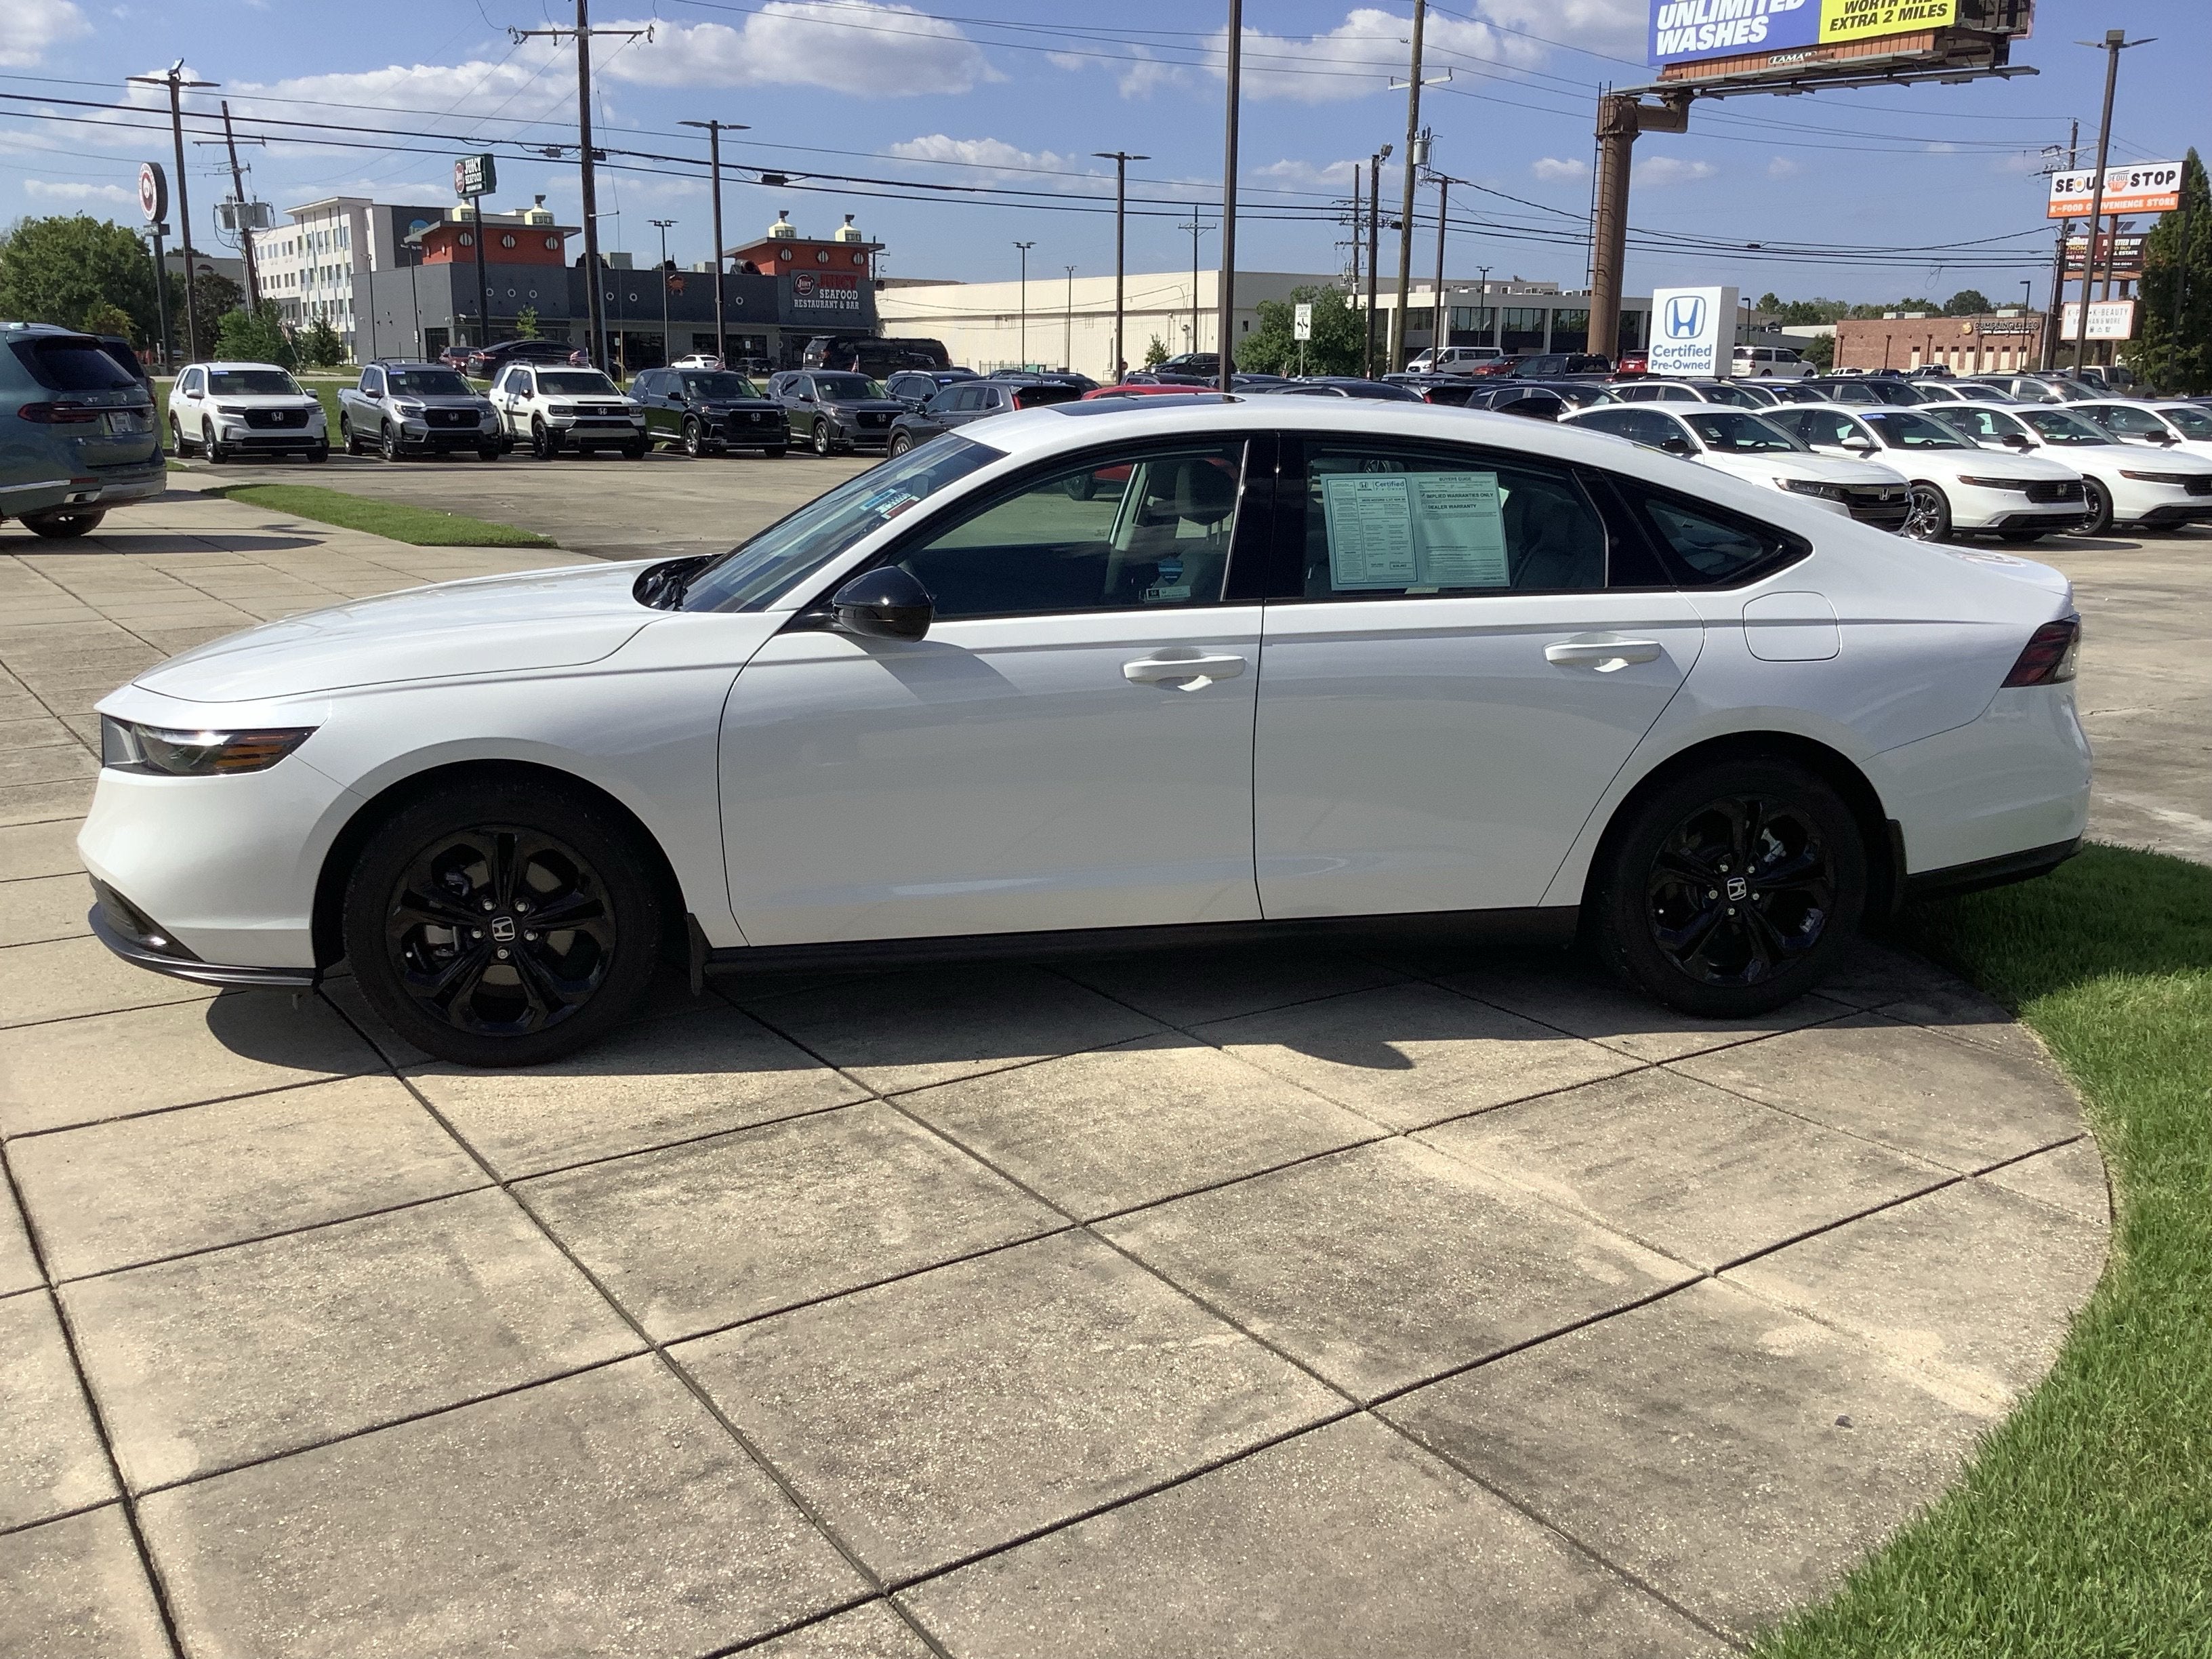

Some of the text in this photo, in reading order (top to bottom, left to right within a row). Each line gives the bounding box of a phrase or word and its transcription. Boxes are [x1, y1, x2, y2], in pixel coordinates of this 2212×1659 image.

[1829, 3, 1948, 31] EXTRA 2 MILES
[1656, 15, 1769, 56] WASHES
[464, 157, 481, 174] JUICY
[2055, 170, 2176, 193] SEOU STOP
[2050, 197, 2176, 213] K-FOOD CNVENIENCE STORE
[819, 289, 859, 300] SEAFOOD
[794, 299, 859, 309] RESTAURANT & BAR
[1652, 344, 1712, 357] Certified
[1651, 359, 1711, 370] Pre-Owned
